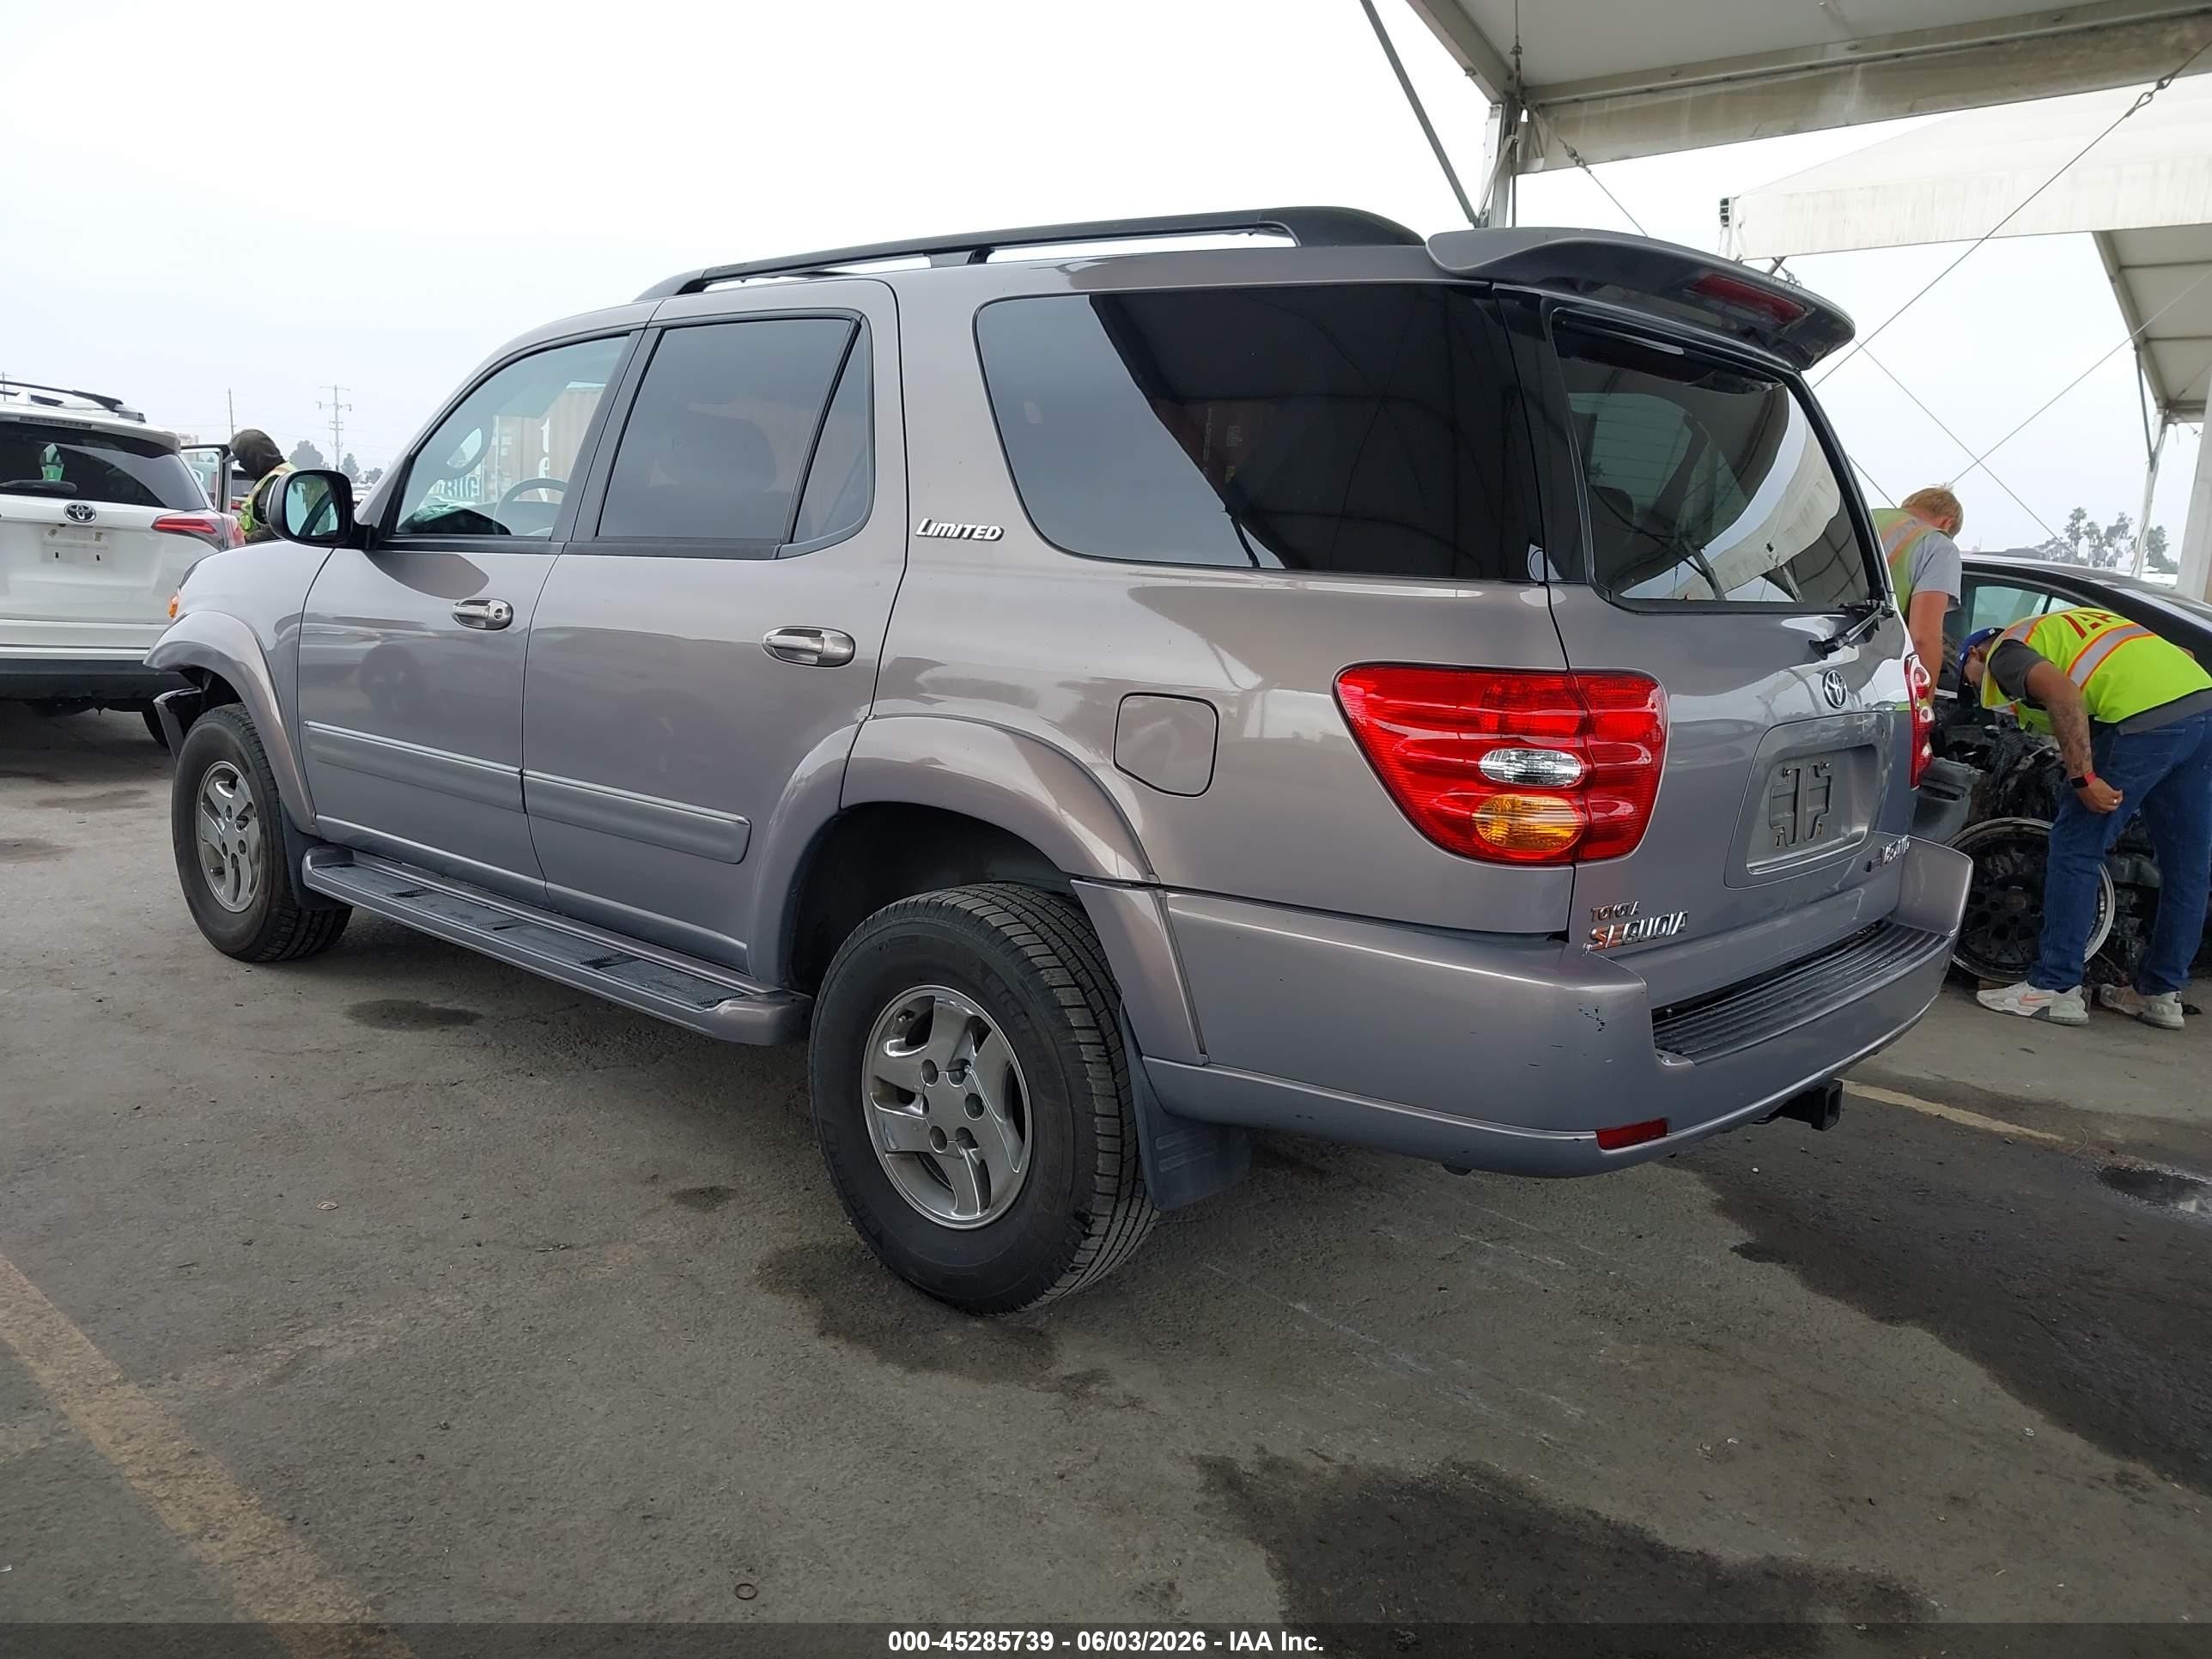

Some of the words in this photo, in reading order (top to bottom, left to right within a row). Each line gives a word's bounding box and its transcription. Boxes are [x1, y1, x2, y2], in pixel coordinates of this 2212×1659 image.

[915, 517, 1005, 542] LIMITED
[1590, 901, 1639, 922] TOYOTA
[1589, 910, 1689, 951] SEQUOIA
